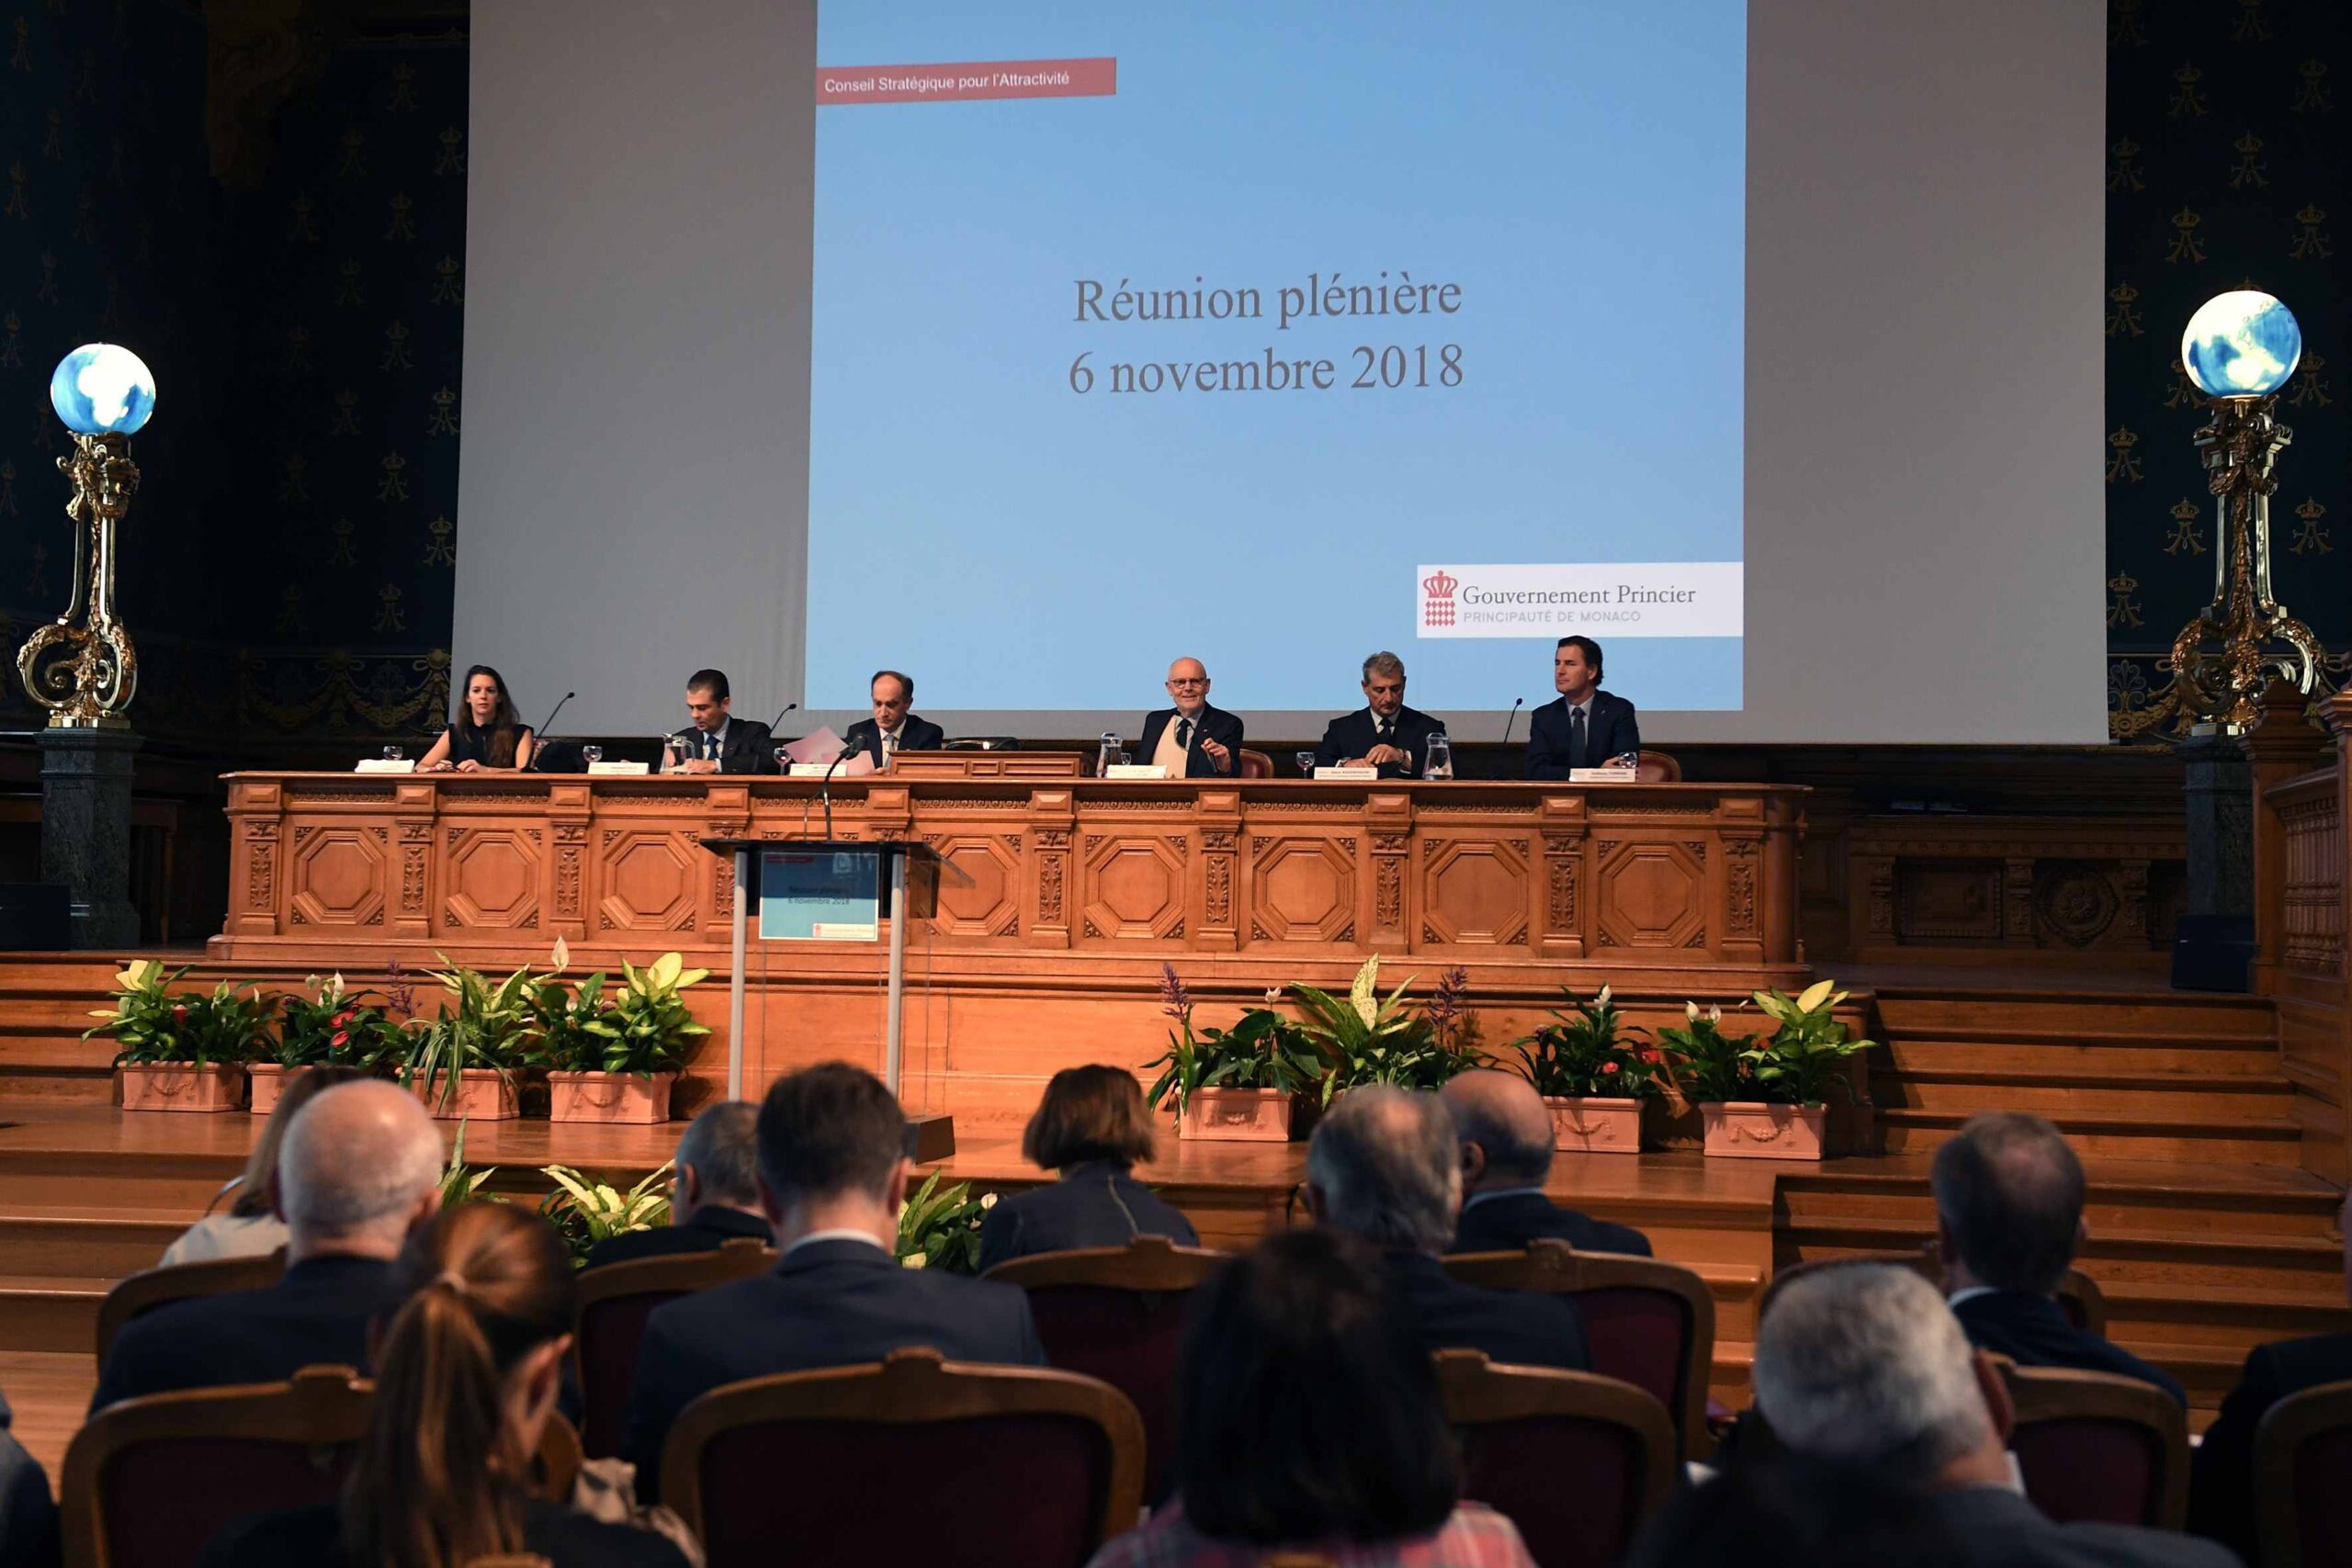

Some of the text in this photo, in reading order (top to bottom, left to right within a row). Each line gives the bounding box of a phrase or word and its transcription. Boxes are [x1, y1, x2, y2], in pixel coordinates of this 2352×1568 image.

[824, 71, 1069, 94] Conseil Stratégique pour l'Attractivité
[1073, 271, 1463, 330] Réunion plénière
[1069, 344, 1464, 394] 6 novembre 2018
[1463, 584, 1697, 604] Gouvernement Princier
[1463, 610, 1642, 623] PRINCIPAUTÉ DE MONACO
